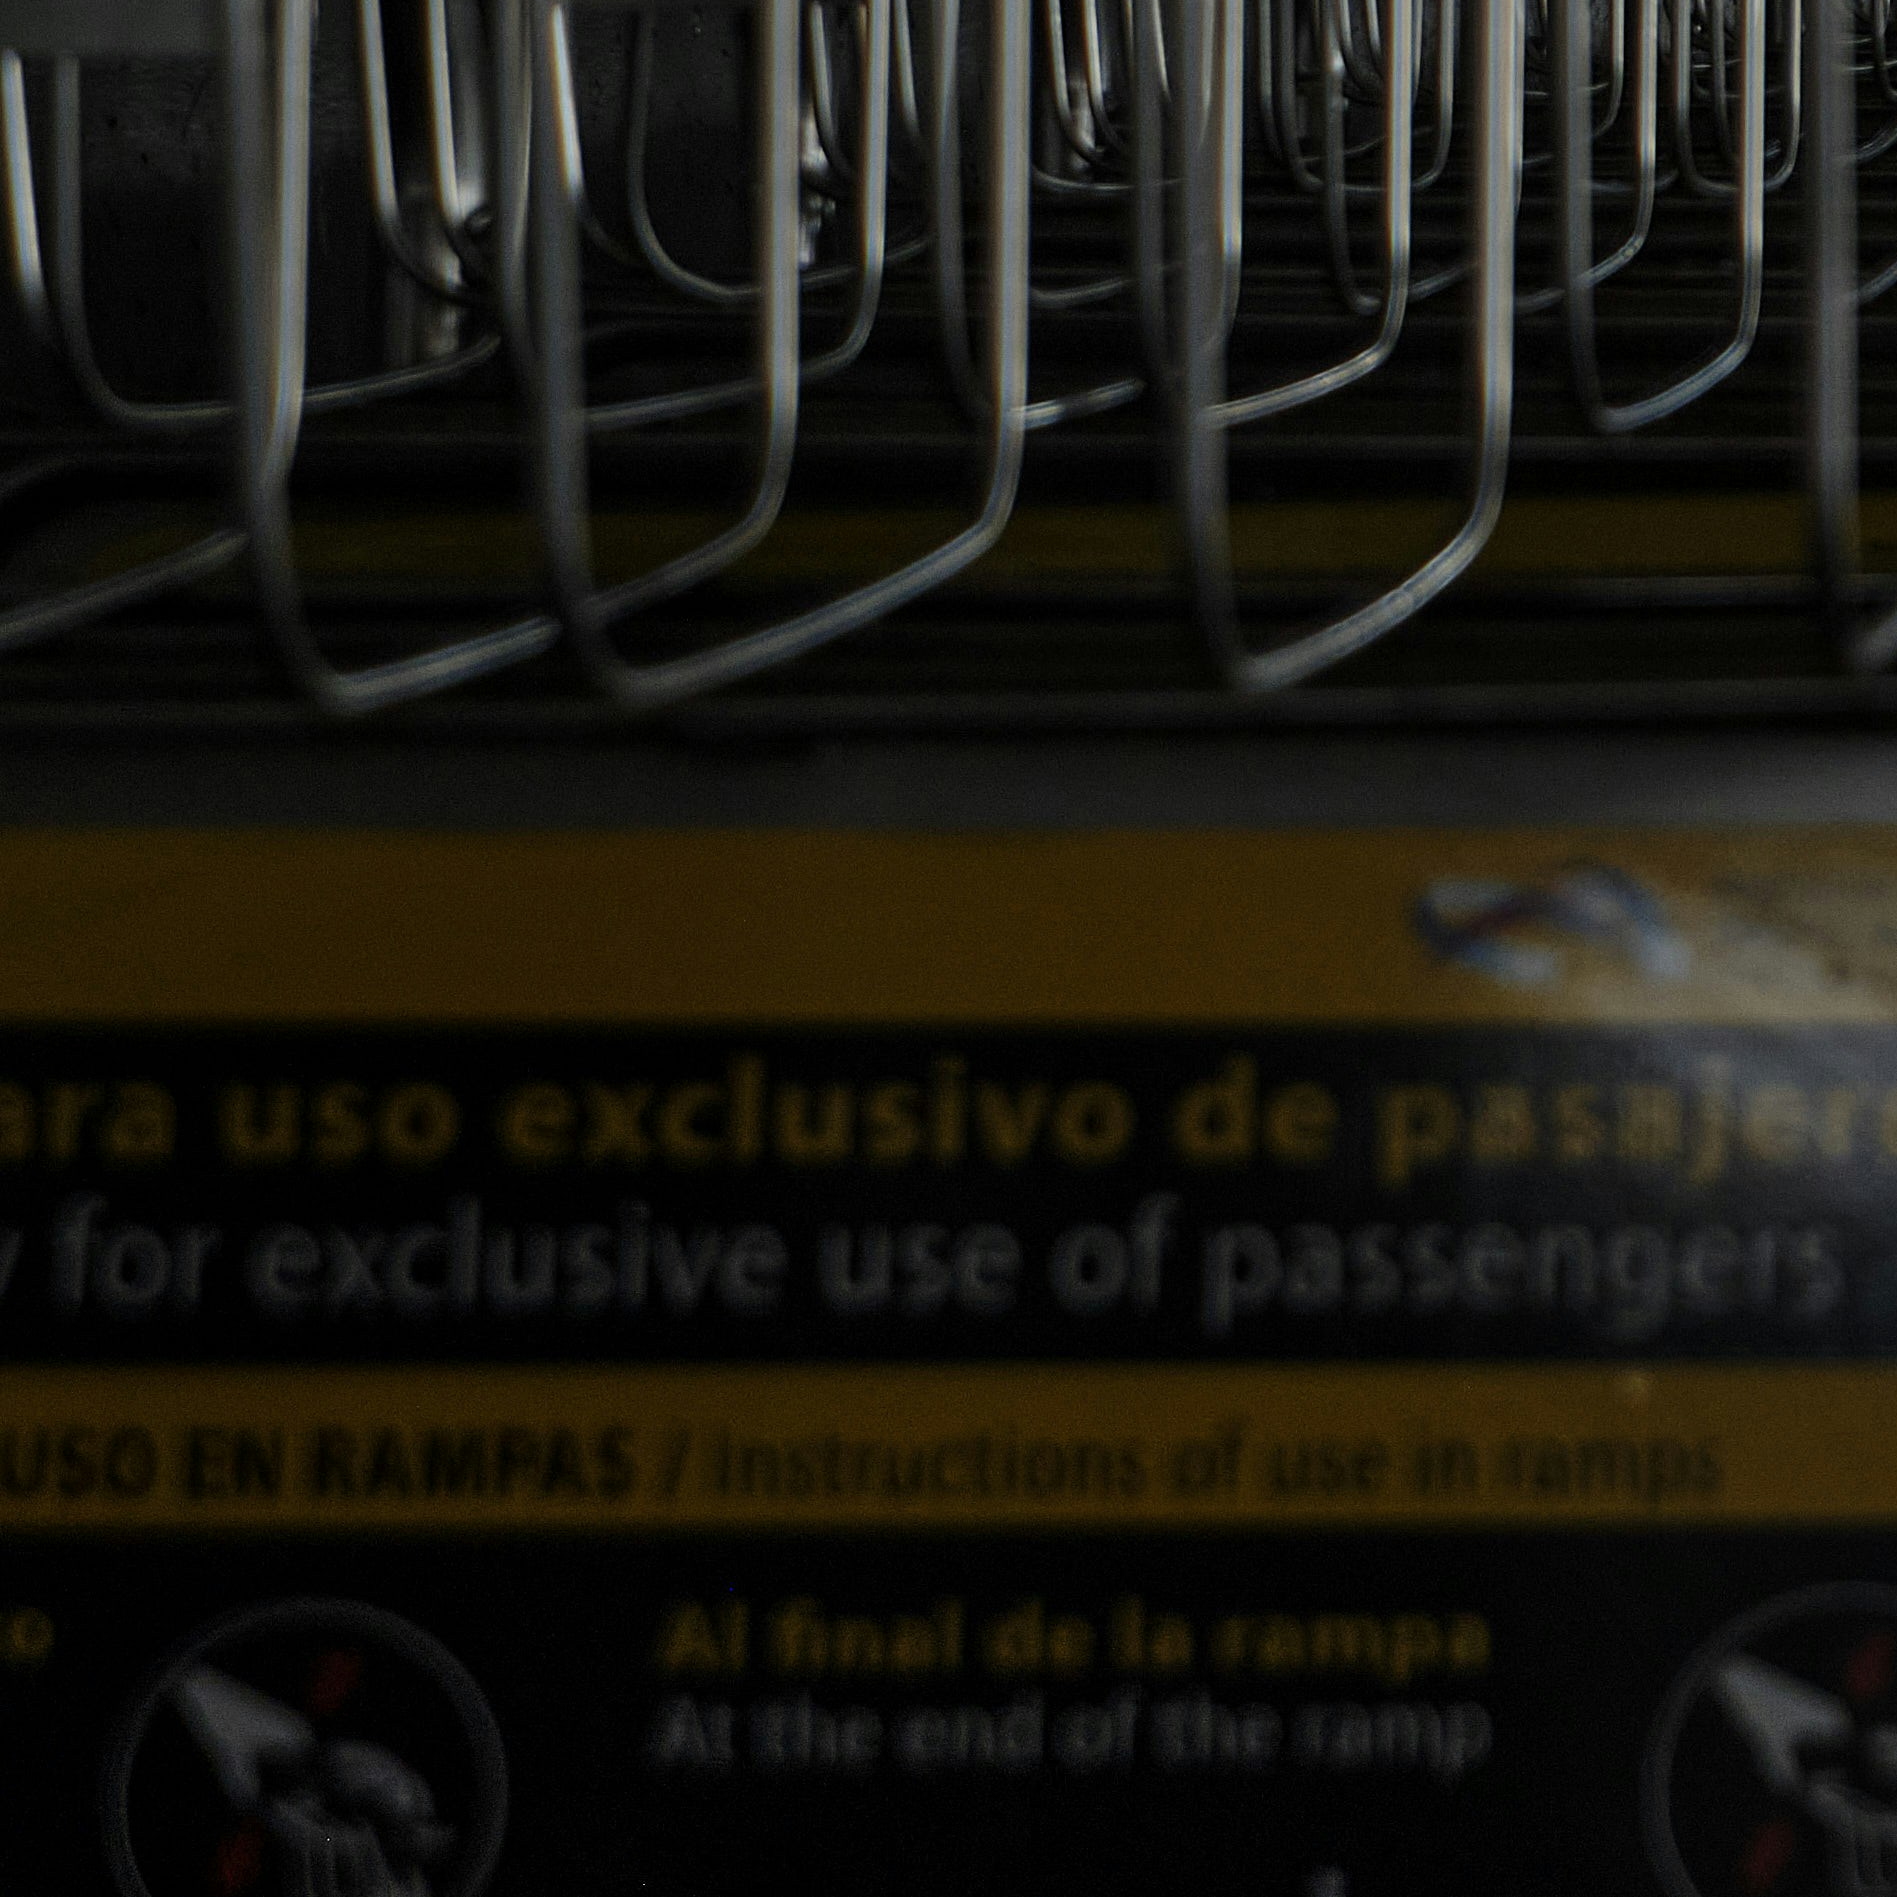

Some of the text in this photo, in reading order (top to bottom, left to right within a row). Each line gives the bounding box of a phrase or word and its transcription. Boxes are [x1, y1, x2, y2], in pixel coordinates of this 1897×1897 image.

[213, 1079, 463, 1170] uso
[497, 1050, 1138, 1169] exclusivo
[1172, 1050, 1340, 1170] de
[52, 1190, 222, 1314] for
[245, 1193, 790, 1316] exclusive
[816, 1220, 1023, 1316] use
[1048, 1190, 1184, 1314] of
[1203, 1220, 1845, 1342] passengers
[2, 1425, 156, 1497] USO
[188, 1427, 285, 1496] EN
[314, 1426, 632, 1497] RAMPAS
[1174, 1422, 1243, 1496] of
[1266, 1438, 1390, 1496] use
[1414, 1426, 1478, 1494] in
[1503, 1437, 1726, 1505] ramps
[650, 1593, 1494, 1688] Al final de la rampa
[646, 1683, 1494, 1784] At the end of the ramp
